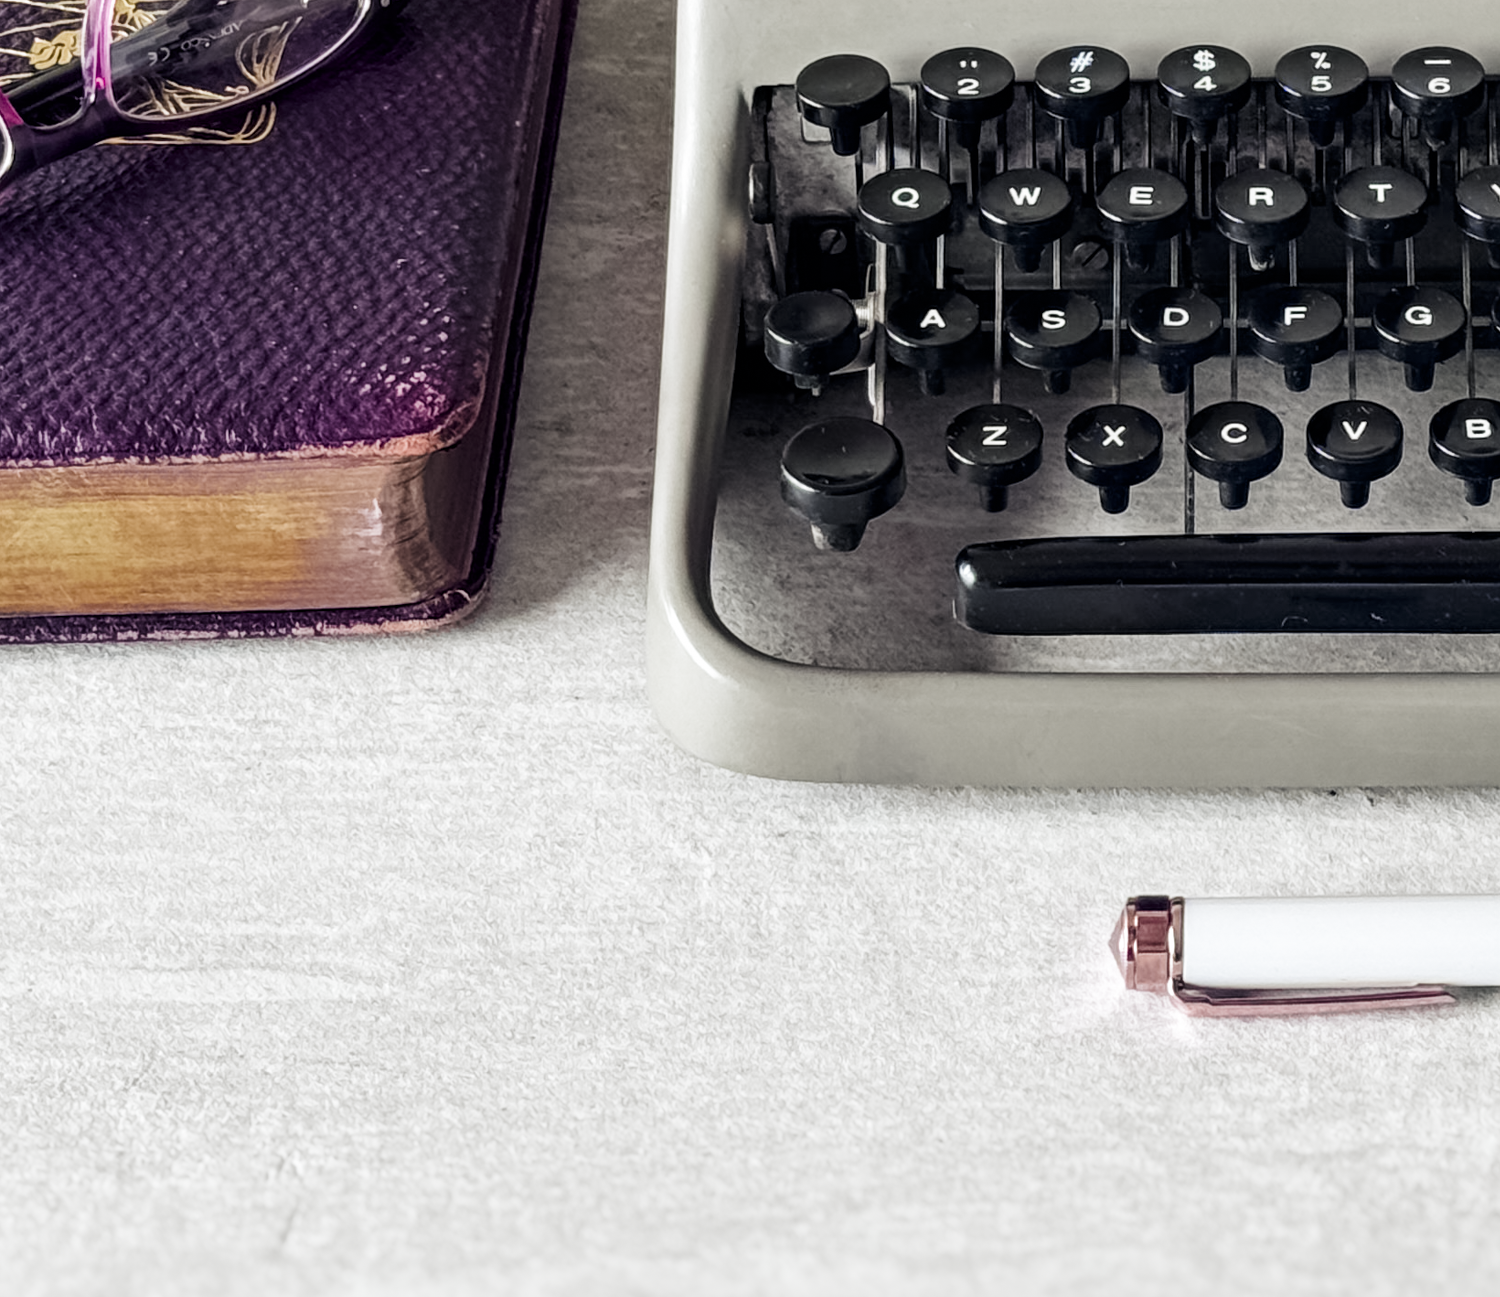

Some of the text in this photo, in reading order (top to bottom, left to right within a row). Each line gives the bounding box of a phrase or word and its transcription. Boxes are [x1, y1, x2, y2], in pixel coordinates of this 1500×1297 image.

[1071, 52, 1094, 73] #
[1193, 50, 1215, 72] $
[1310, 51, 1332, 70] %
[957, 78, 980, 95] 2
[1068, 76, 1092, 94] 3
[1193, 75, 1217, 92] 4
[1310, 75, 1333, 92] 5
[1427, 77, 1451, 97] 6
[891, 187, 920, 209] Q
[1008, 186, 1041, 206] W
[1129, 186, 1154, 205] E
[1248, 186, 1274, 206] R
[1368, 183, 1393, 203] T
[920, 308, 946, 328] A
[1041, 309, 1066, 330] S
[1163, 307, 1190, 327] D
[1284, 306, 1308, 326] F
[1404, 305, 1433, 326] G
[982, 425, 1008, 446] Z
[1102, 425, 1126, 447] X
[1220, 422, 1247, 444] C
[1342, 421, 1368, 440] V
[1465, 418, 1492, 439] B
